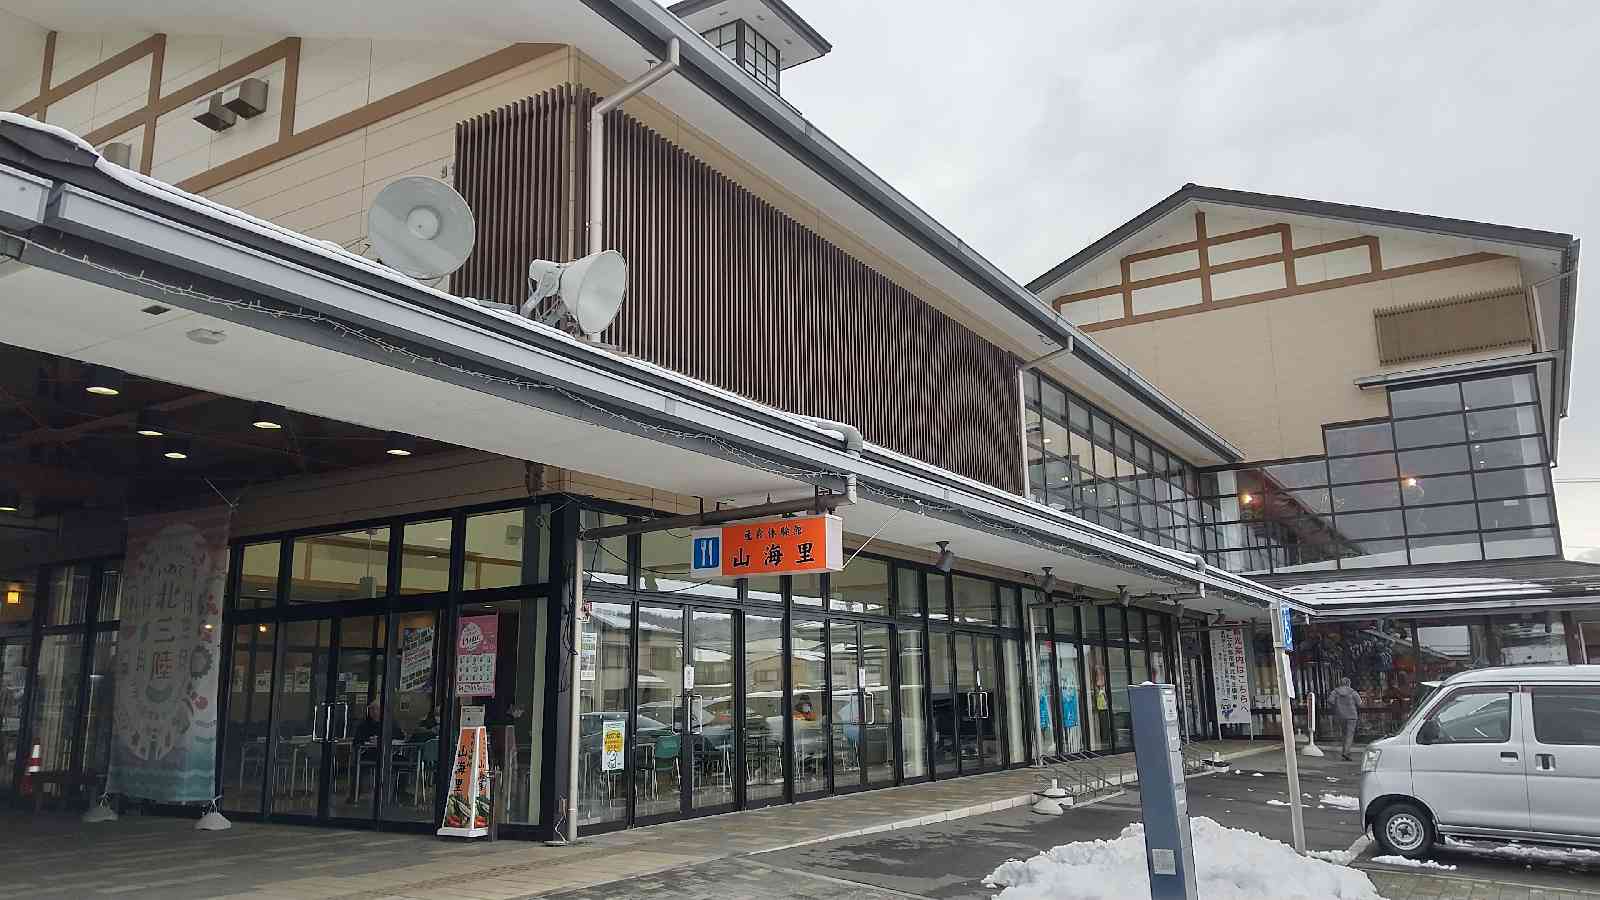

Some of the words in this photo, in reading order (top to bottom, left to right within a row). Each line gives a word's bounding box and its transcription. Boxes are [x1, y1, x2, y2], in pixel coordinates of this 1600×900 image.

[733, 543, 814, 567] 山海里
[151, 581, 180, 681] 北三陸
